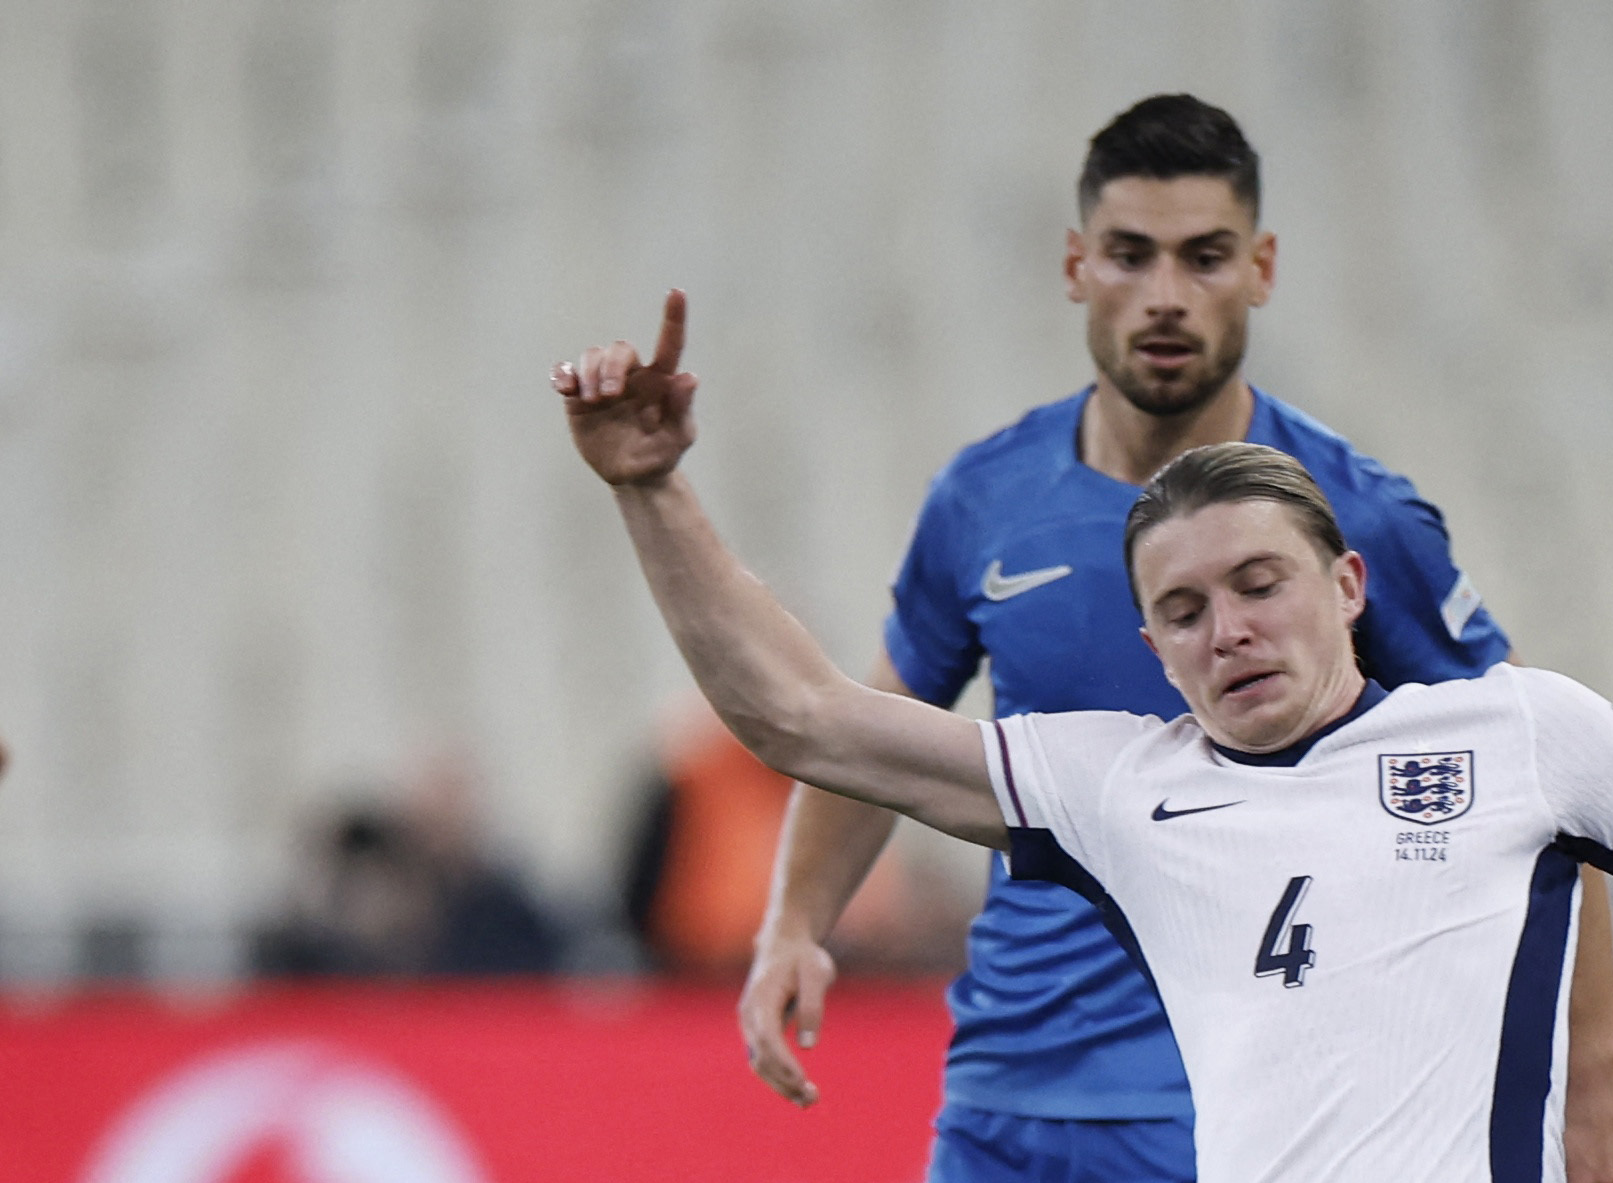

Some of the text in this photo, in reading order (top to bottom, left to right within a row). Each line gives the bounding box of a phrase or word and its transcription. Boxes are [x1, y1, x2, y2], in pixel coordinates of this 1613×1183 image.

[1396, 831, 1450, 845] GREECE
[1395, 847, 1447, 862] 14.11.24
[1254, 875, 1316, 988] 4
